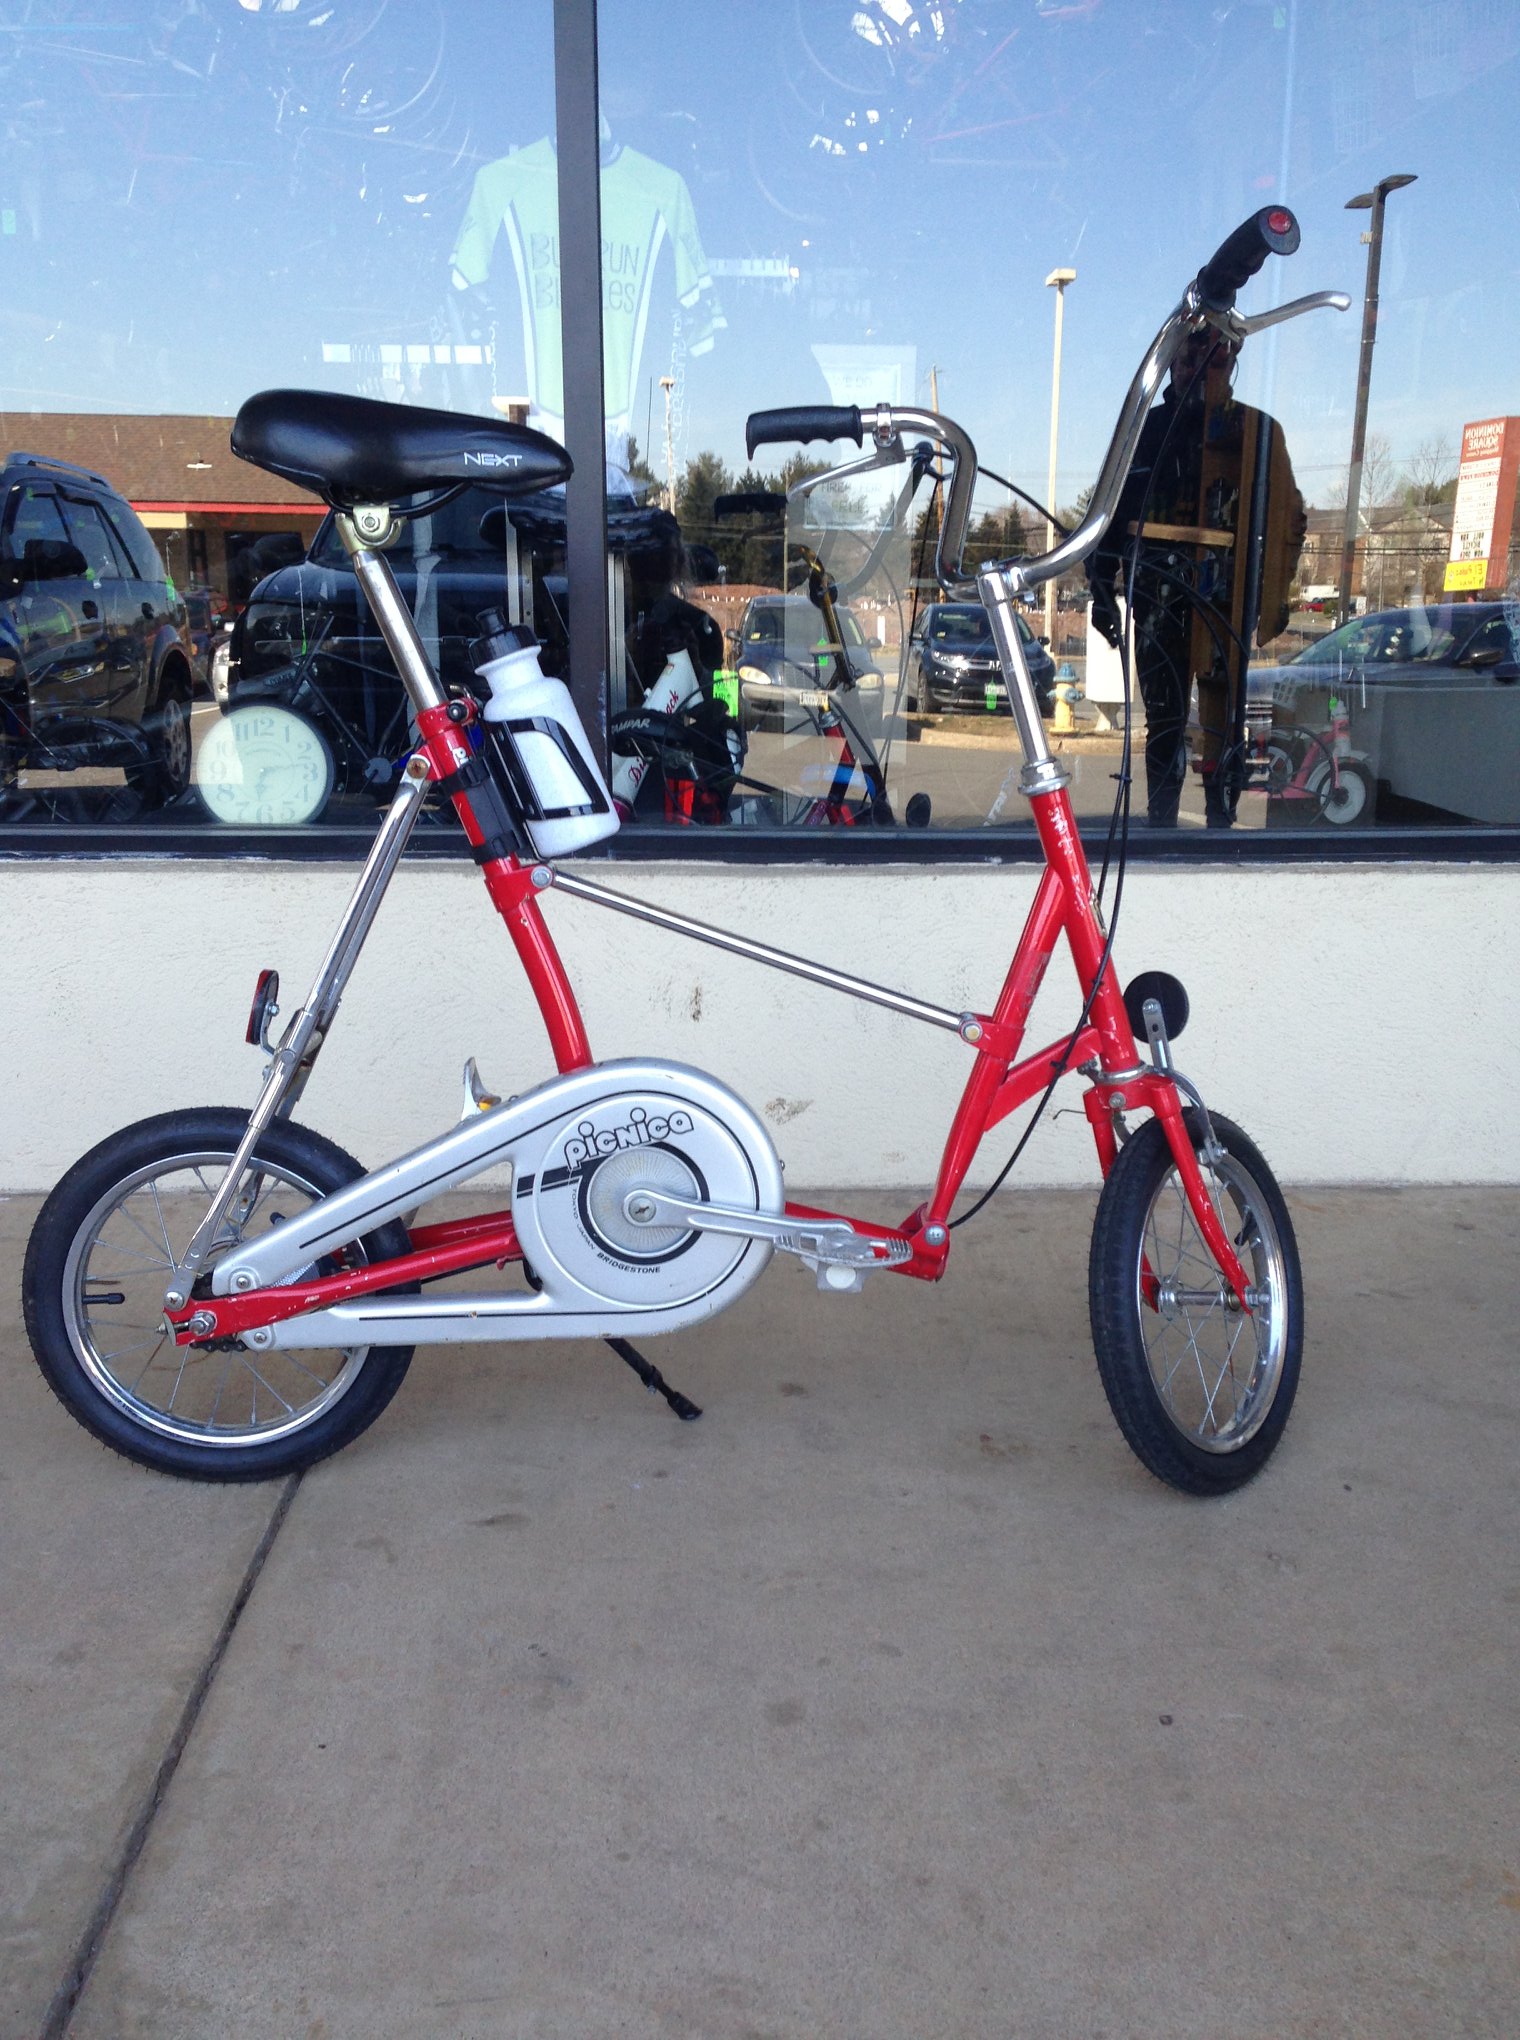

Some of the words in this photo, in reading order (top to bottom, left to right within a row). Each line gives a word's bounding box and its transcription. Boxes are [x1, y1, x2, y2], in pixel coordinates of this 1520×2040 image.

[463, 452, 523, 467] NEXT
[253, 717, 275, 737] 12
[297, 742, 312, 761] 2
[209, 759, 228, 781] 9
[303, 762, 319, 782] 3
[216, 783, 235, 803] 8
[235, 801, 250, 822] 7
[255, 803, 274, 824] 6
[571, 1188, 579, 1220] TOKYO
[576, 1223, 596, 1251] JAPAN
[596, 1251, 661, 1275] BRIDGESTONE
